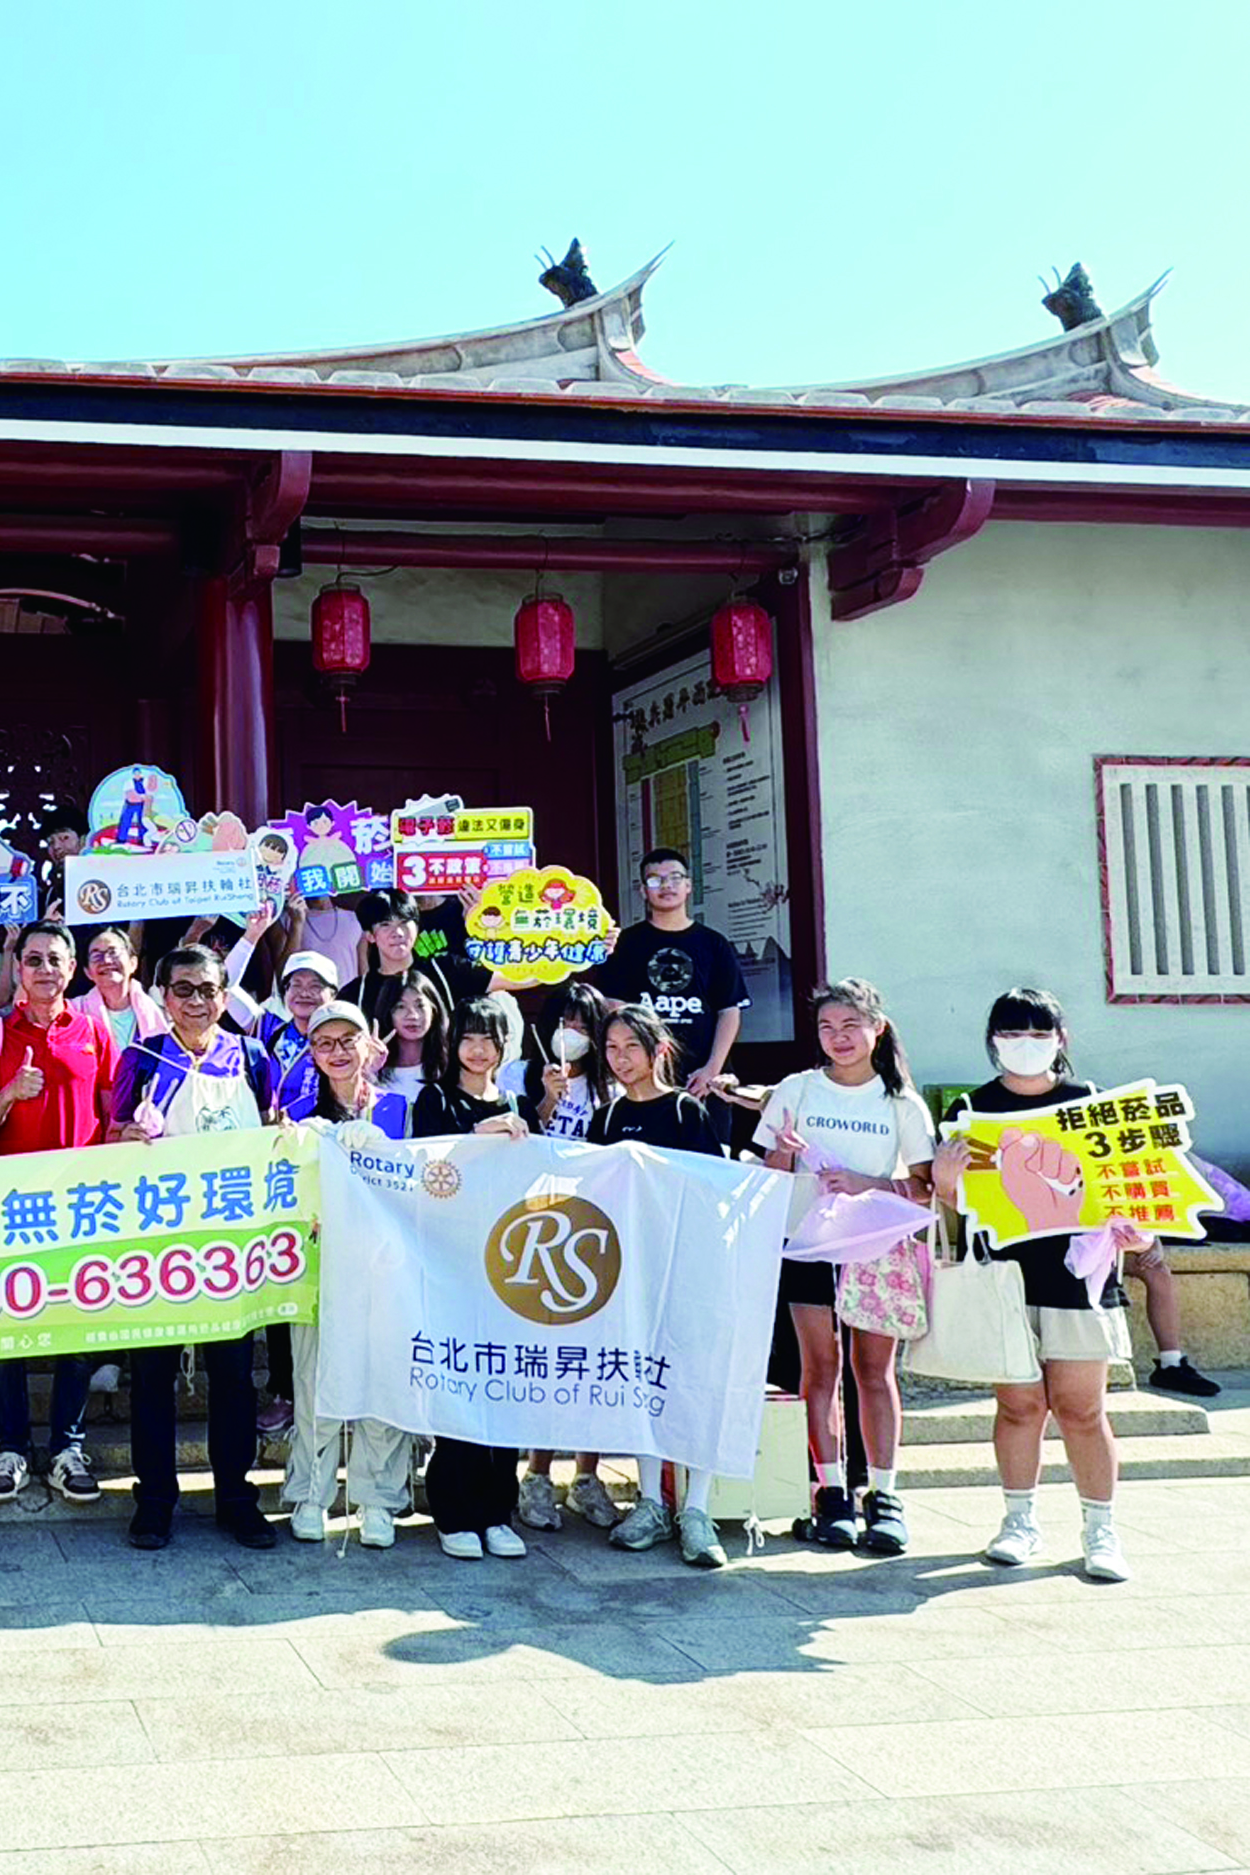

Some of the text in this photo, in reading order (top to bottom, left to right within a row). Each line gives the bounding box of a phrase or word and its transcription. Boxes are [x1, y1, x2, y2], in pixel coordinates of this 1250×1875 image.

[116, 877, 252, 898] 台北市瑞昇扶輪社
[300, 861, 394, 892] 我開始
[465, 936, 606, 964] 守護青少年健康
[1055, 1091, 1187, 1132] 拒絕菸品
[806, 1116, 890, 1136] CROWORLD
[350, 1150, 415, 1179] Rotary
[1095, 1158, 1166, 1179] 不嘗試
[1100, 1180, 1170, 1201] 不購買
[1104, 1204, 1175, 1222] 不推薦
[500, 1210, 609, 1313] RS
[0, 1333, 51, 1350] 關心您
[411, 1330, 671, 1390] 台北市瑞昇扶社
[410, 1366, 477, 1402] Rotary
[485, 1379, 546, 1404] Club
[554, 1383, 580, 1404] of
[589, 1384, 626, 1407] Rui
